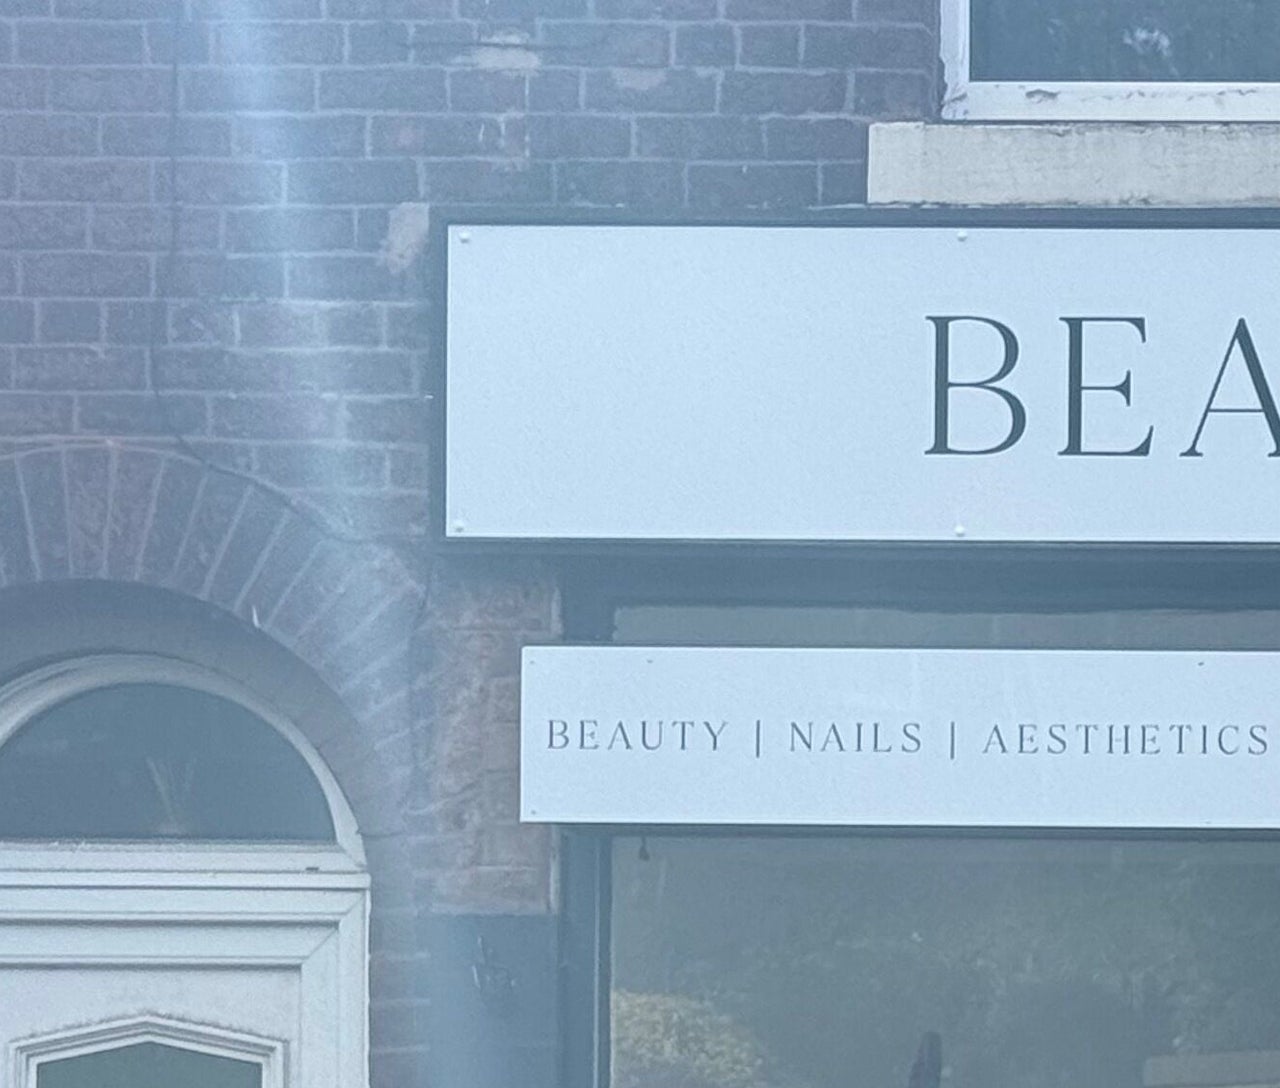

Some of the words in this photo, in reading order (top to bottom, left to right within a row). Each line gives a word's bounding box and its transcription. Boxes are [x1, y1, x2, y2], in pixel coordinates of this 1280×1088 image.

[546, 718, 730, 752] BEAUTY
[788, 721, 923, 754] NAILS
[982, 723, 1271, 756] AESTHETICS
